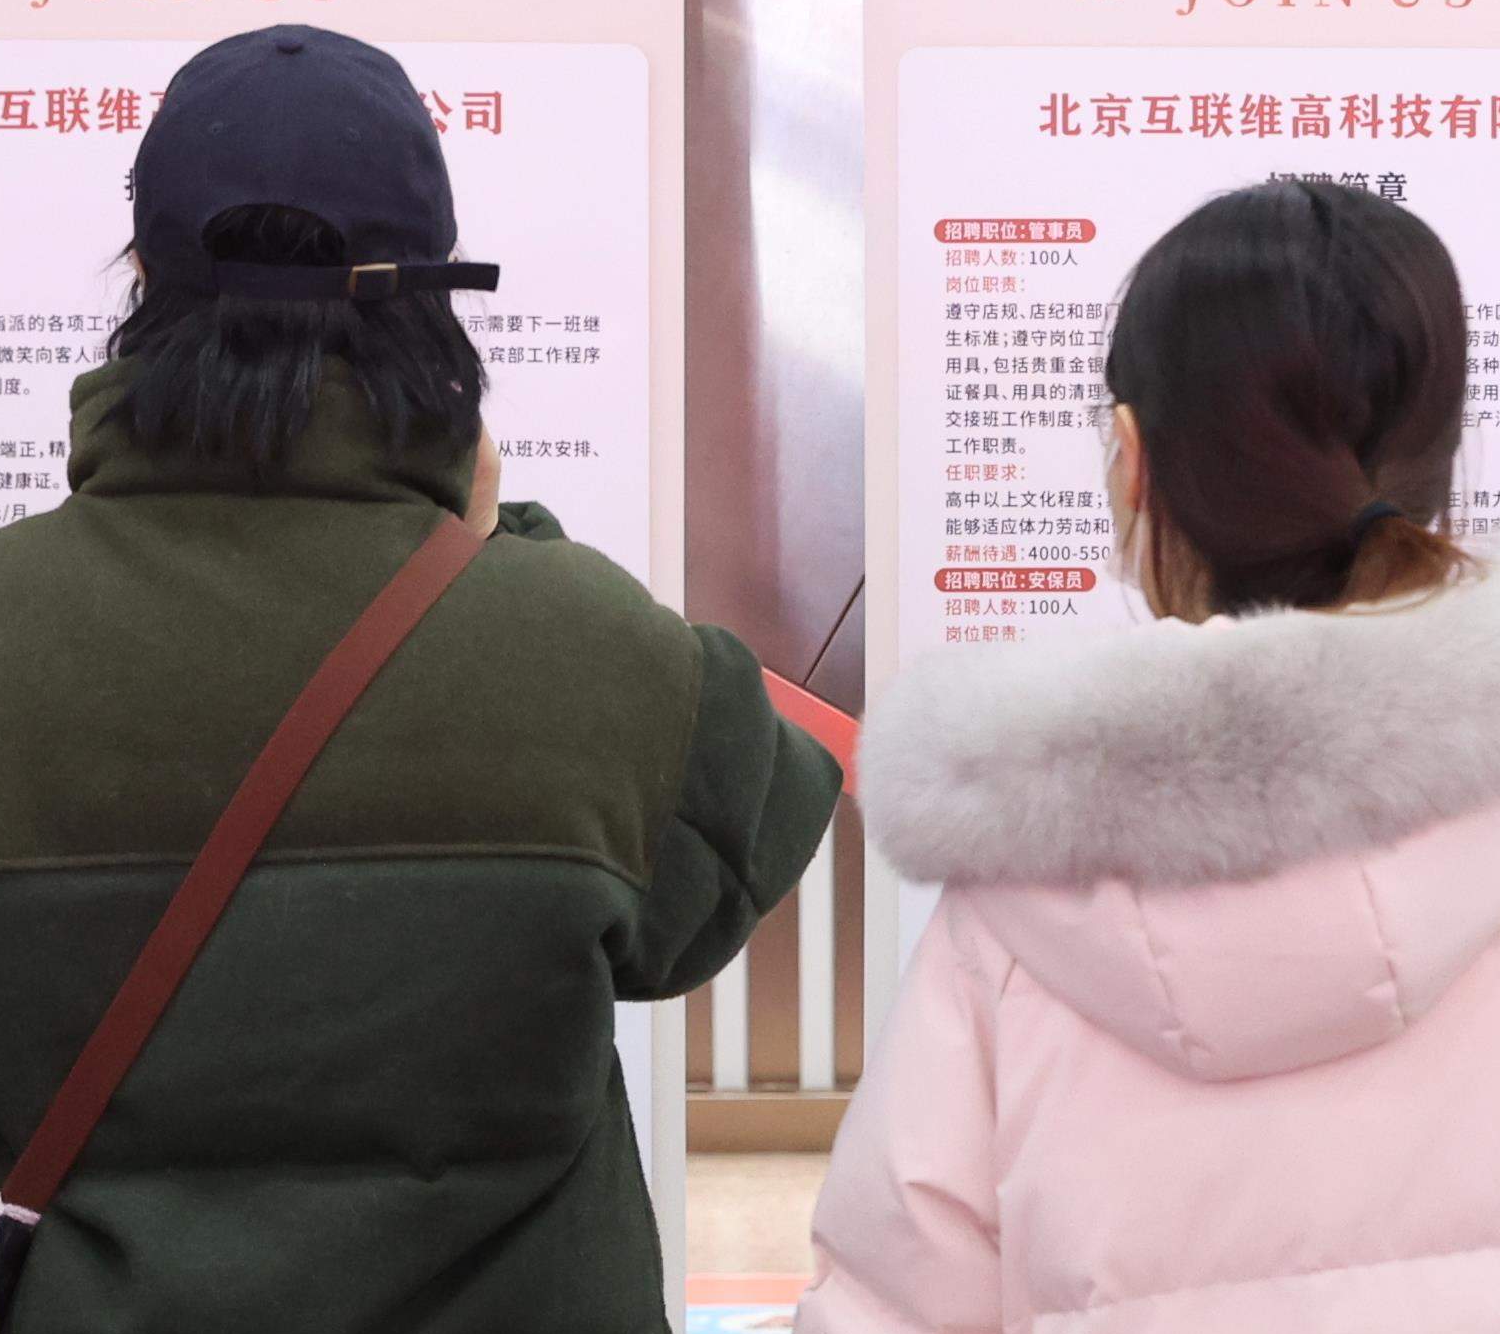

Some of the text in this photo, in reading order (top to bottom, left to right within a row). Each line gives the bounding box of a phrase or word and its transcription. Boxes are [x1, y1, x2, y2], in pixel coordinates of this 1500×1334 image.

[945, 221, 1083, 241] 招聘职位：管事员
[945, 249, 1078, 267] 招聘人数：100人
[946, 276, 1025, 294] 岗位职责：
[946, 437, 1027, 455] 工作职责。
[946, 464, 1026, 482] 任职要求：
[945, 571, 1083, 589] 招聘职位：安保员
[946, 598, 1078, 616] 招聘人数：100人
[946, 625, 1026, 643] 岗位职责：
